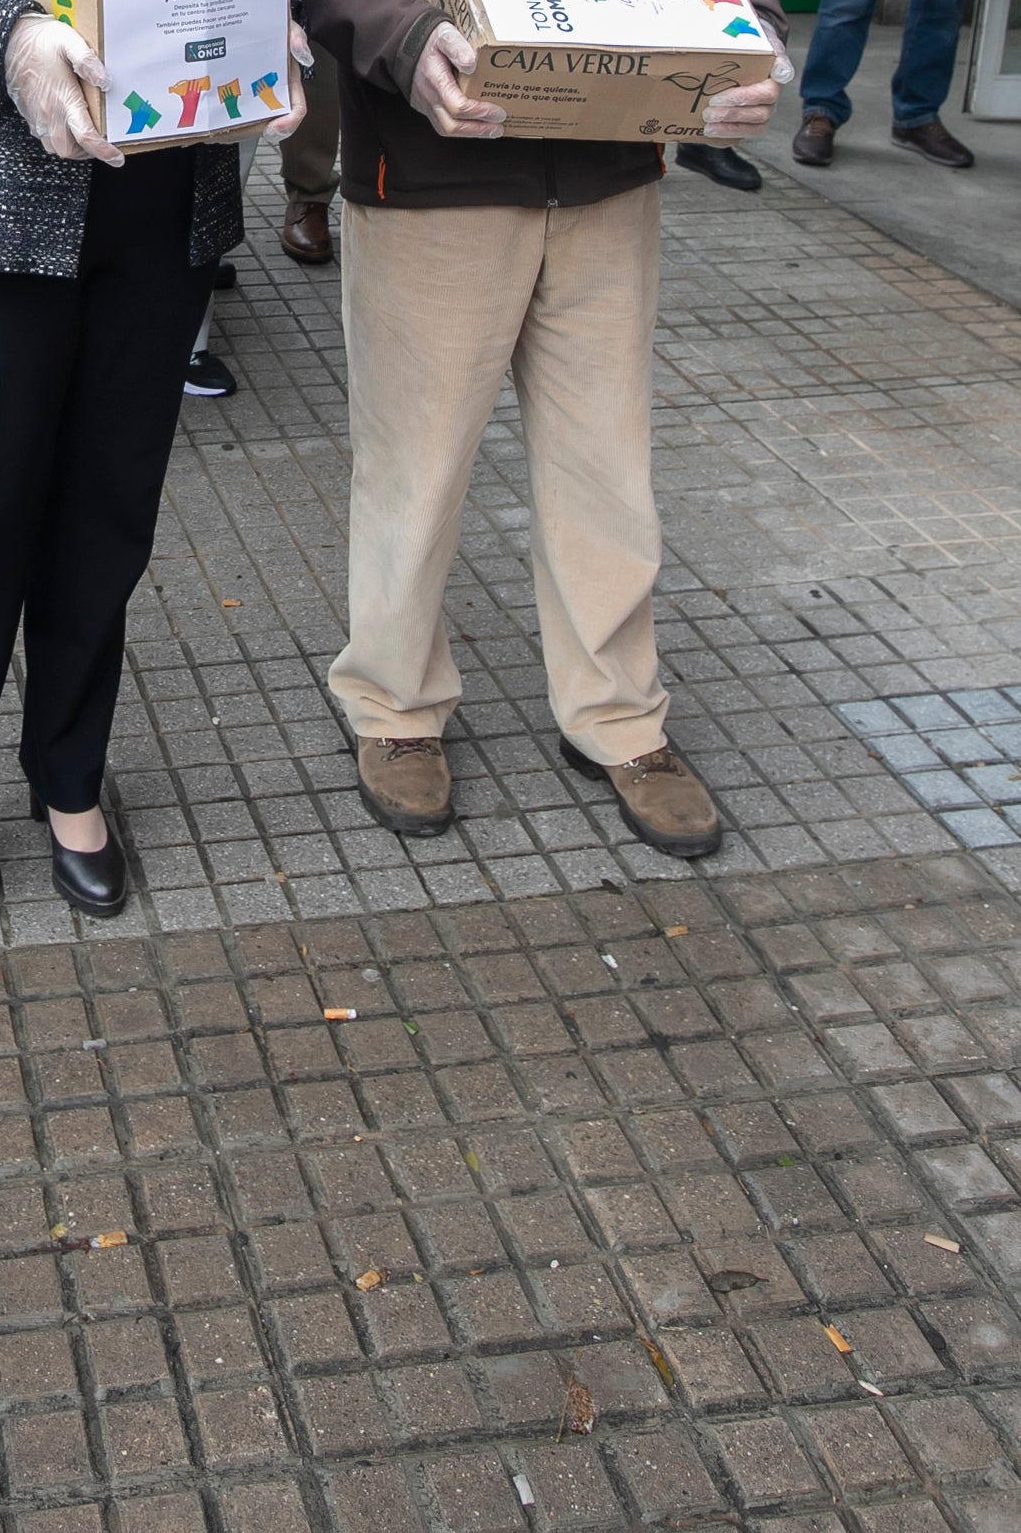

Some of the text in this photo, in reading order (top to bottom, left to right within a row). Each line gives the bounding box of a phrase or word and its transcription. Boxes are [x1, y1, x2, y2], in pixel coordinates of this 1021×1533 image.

[198, 46, 225, 59] ONCE
[490, 49, 652, 76] CAJA VERDE
[484, 81, 510, 90] Envía
[522, 84, 542, 92] que
[480, 91, 520, 100] protege
[532, 94, 550, 102] que
[552, 94, 587, 103] quieres
[664, 124, 705, 136] Corre
